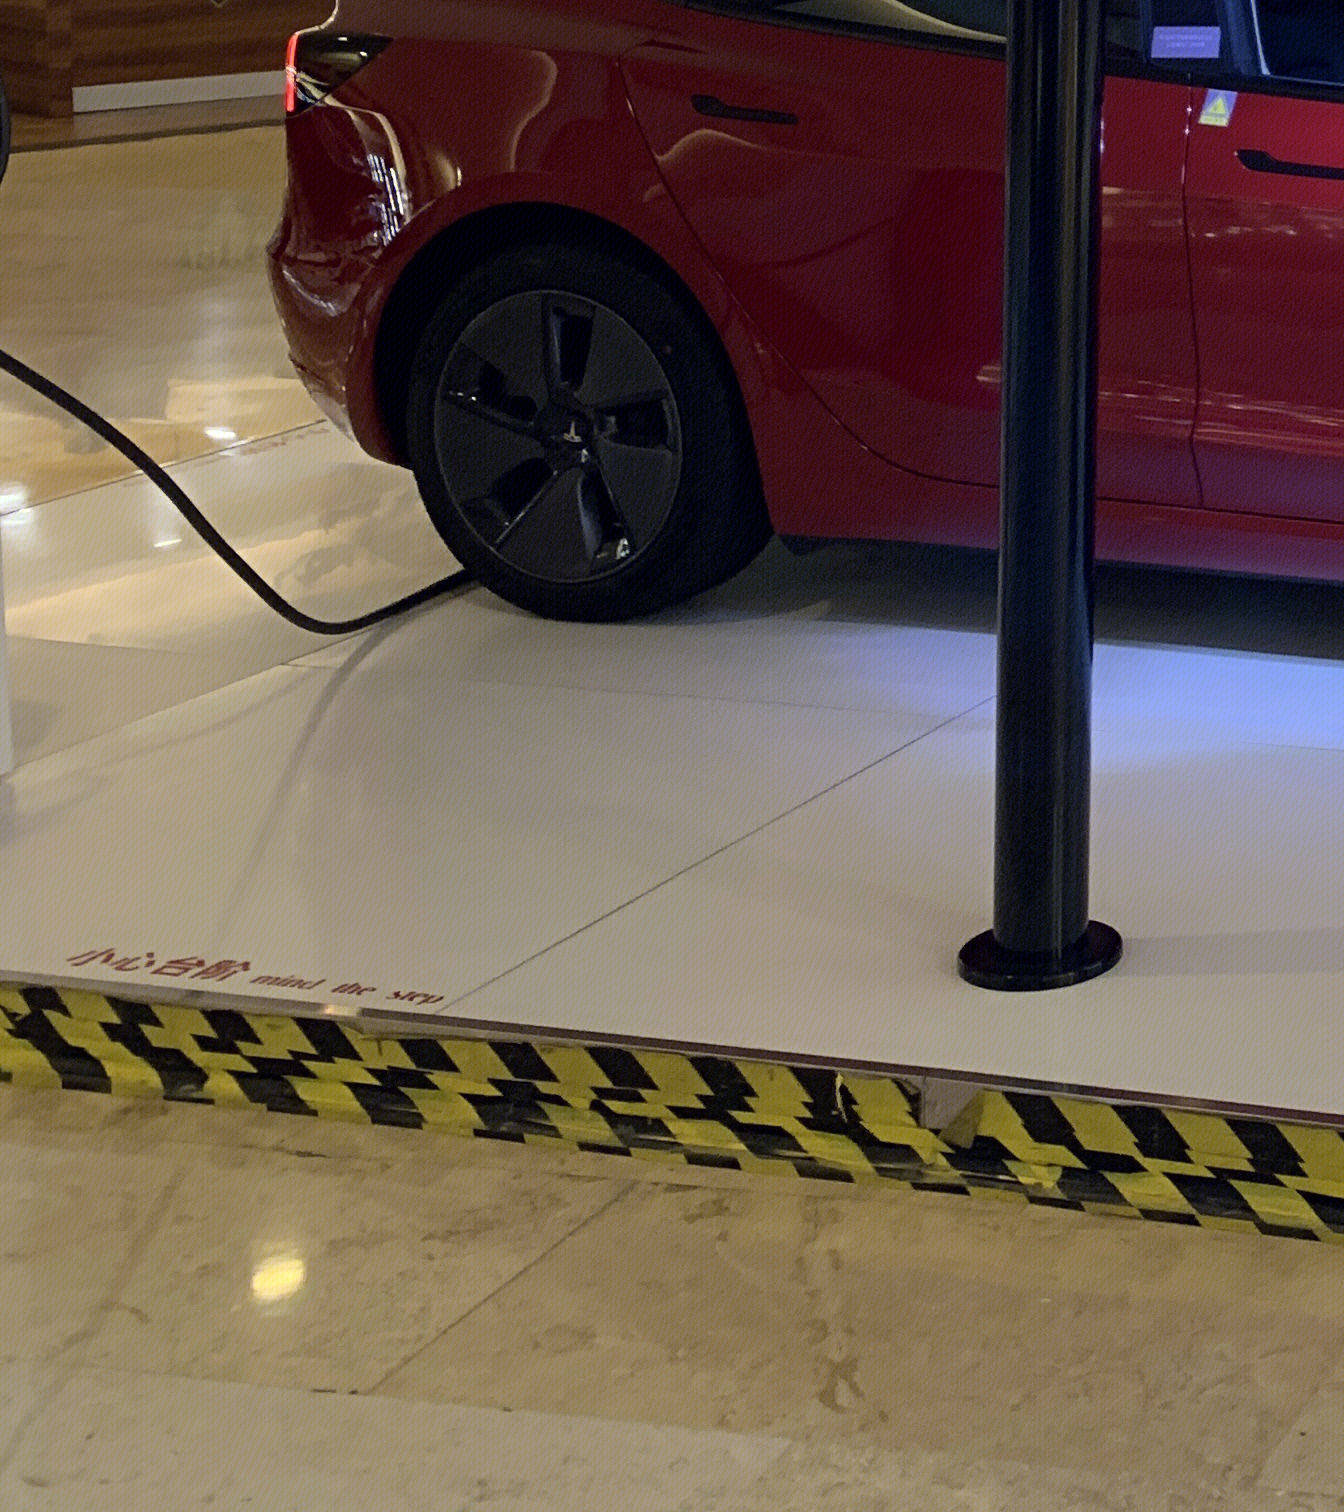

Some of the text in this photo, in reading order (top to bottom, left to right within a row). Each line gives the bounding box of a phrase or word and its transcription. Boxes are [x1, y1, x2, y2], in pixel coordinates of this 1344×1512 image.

[67, 947, 251, 982] 小心台阶
[250, 973, 326, 991] mind
[331, 982, 377, 996] the
